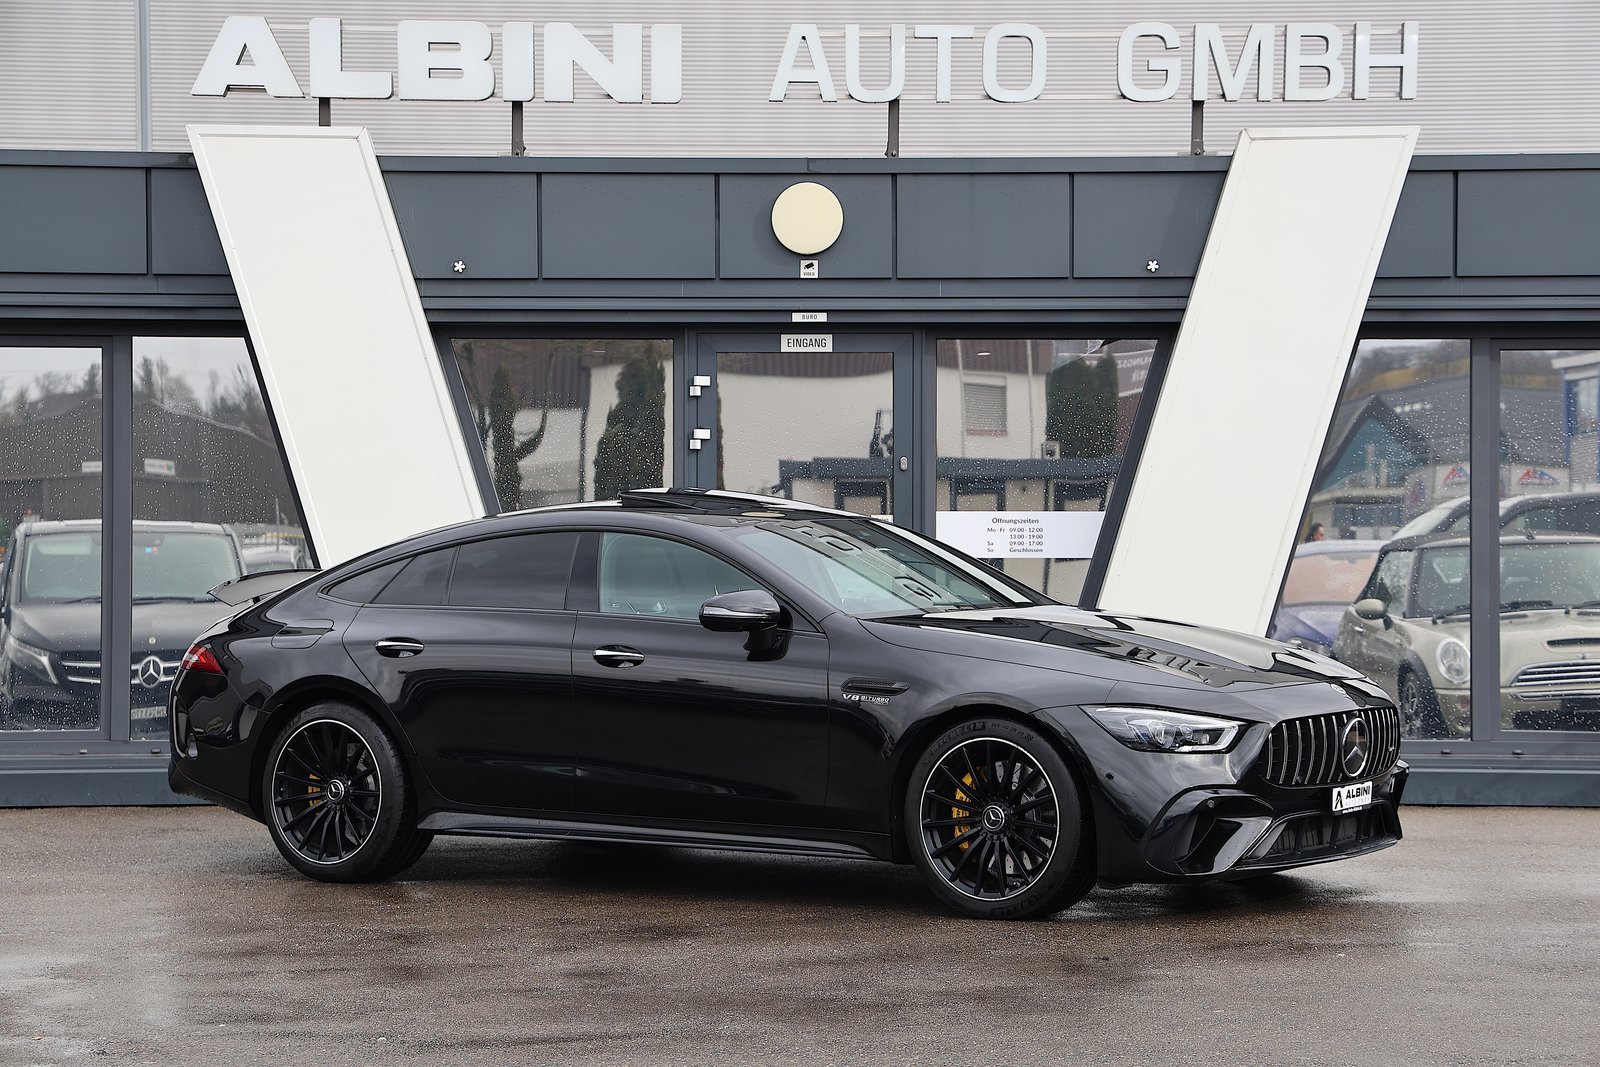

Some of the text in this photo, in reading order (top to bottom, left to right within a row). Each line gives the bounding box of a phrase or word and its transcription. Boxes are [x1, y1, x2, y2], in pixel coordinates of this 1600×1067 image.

[191, 16, 1419, 104] ALBINI AUTO GMBH
[787, 338, 827, 348] EINGANG
[843, 693, 860, 701] V8
[1345, 785, 1370, 799] ALBINI
